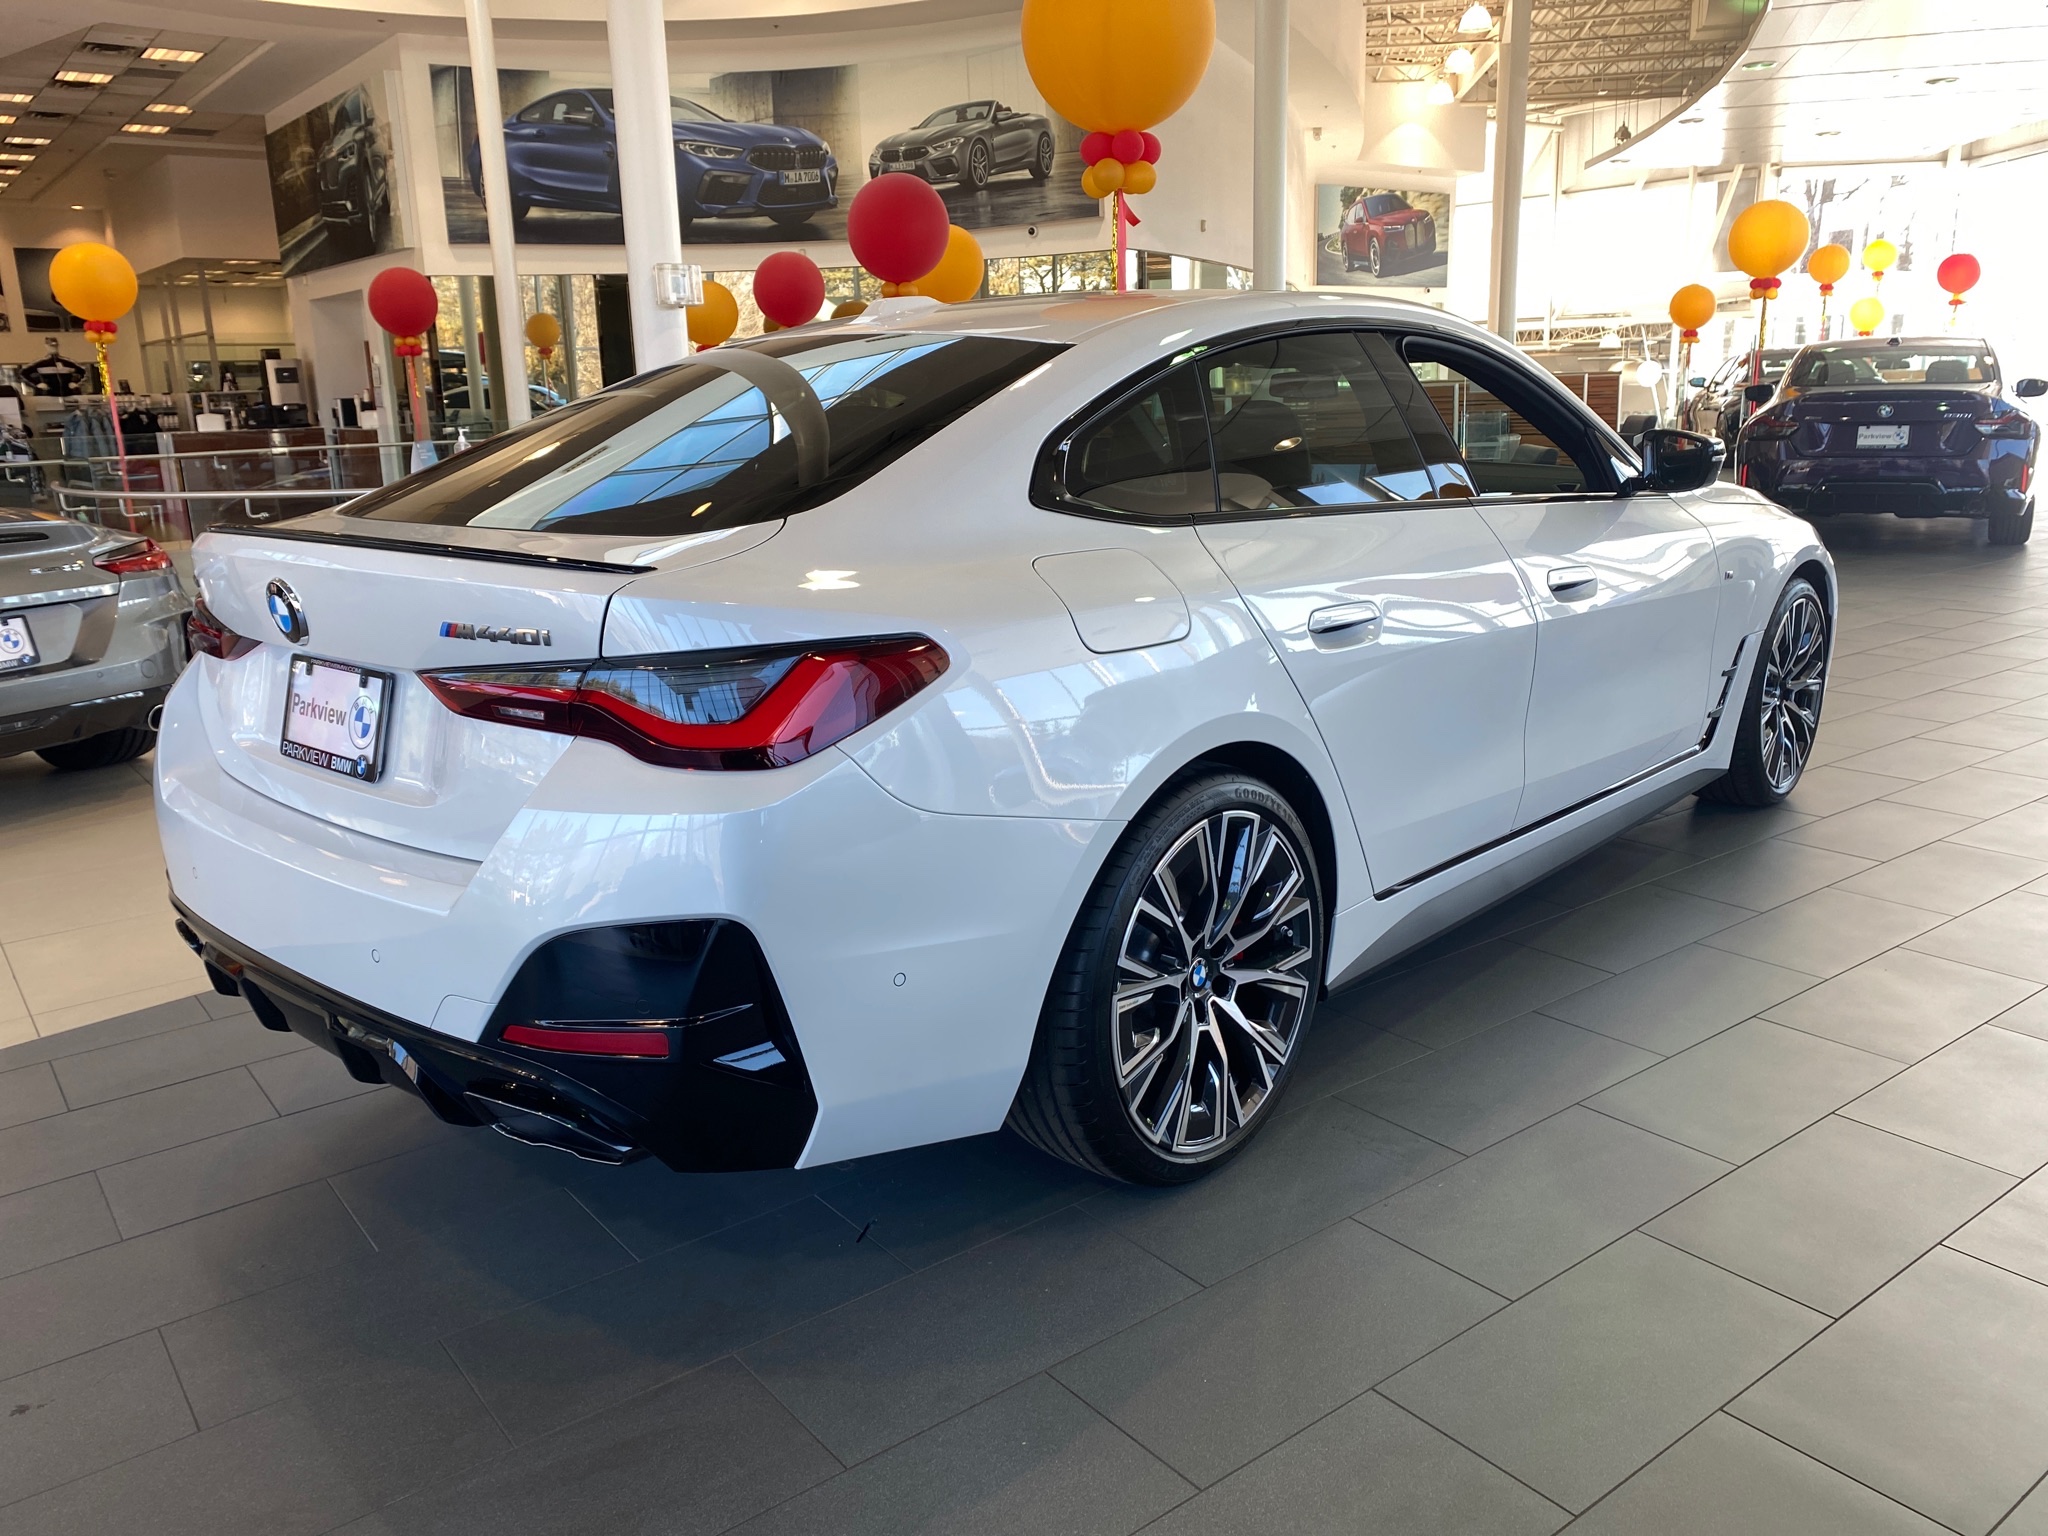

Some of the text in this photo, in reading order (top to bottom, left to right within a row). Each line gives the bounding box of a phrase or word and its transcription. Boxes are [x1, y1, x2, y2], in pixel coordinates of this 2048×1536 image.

[455, 623, 552, 646] M440i
[310, 659, 361, 674] PARKVIEWBMW.COM
[292, 692, 347, 726] Parkview
[282, 741, 353, 773] PARKVIEW BMW
[1234, 787, 1296, 826] GOODYEAR
